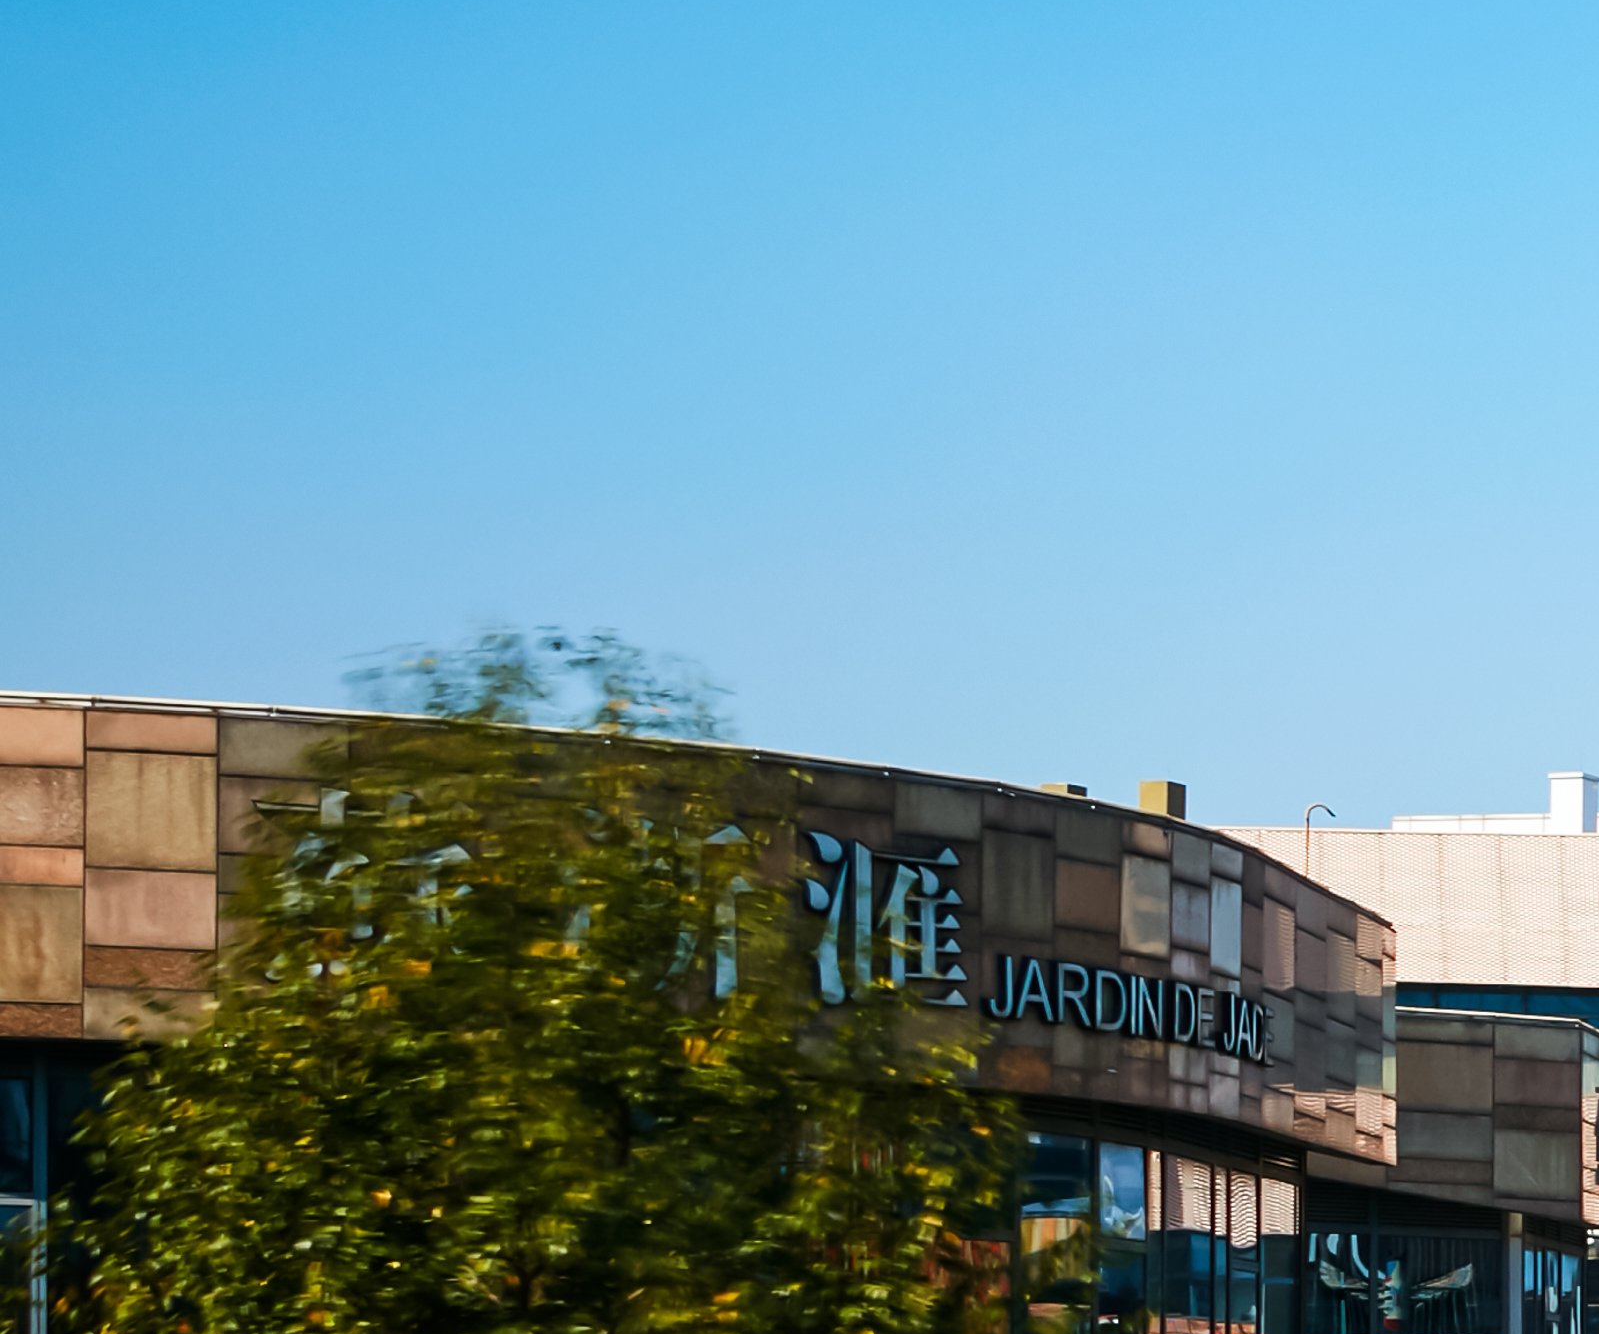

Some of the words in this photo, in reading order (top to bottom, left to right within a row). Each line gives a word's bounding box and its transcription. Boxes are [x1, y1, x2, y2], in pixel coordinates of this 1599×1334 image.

[987, 953, 1164, 1038] JARDIN
[1173, 982, 1217, 1049] DE
[1223, 991, 1276, 1066] JADE
